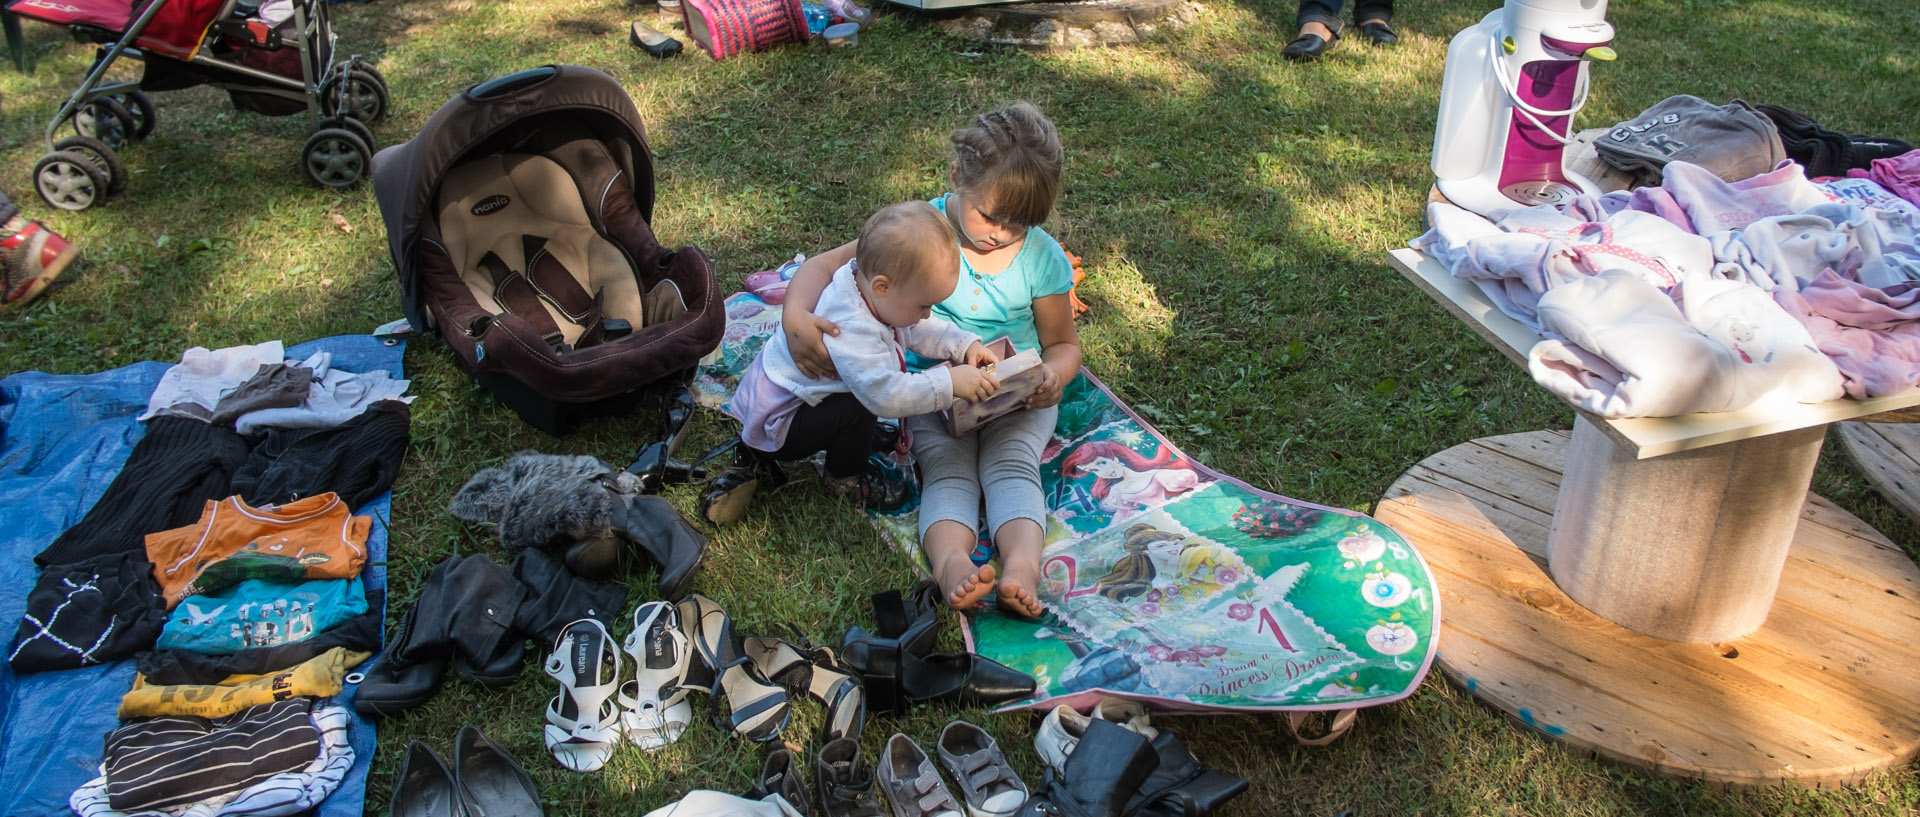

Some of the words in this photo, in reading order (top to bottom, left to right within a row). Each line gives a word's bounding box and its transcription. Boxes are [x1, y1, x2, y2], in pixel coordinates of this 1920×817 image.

[474, 197, 508, 214] nania
[1388, 541, 1409, 559] 8
[1043, 555, 1099, 603] 2
[1411, 587, 1428, 611] 7
[1258, 607, 1299, 653] 1
[578, 643, 589, 674] Laureana
[1212, 660, 1258, 678] Dream
[1261, 653, 1270, 661] a
[1272, 653, 1342, 683] Dream
[1394, 655, 1414, 671] 6
